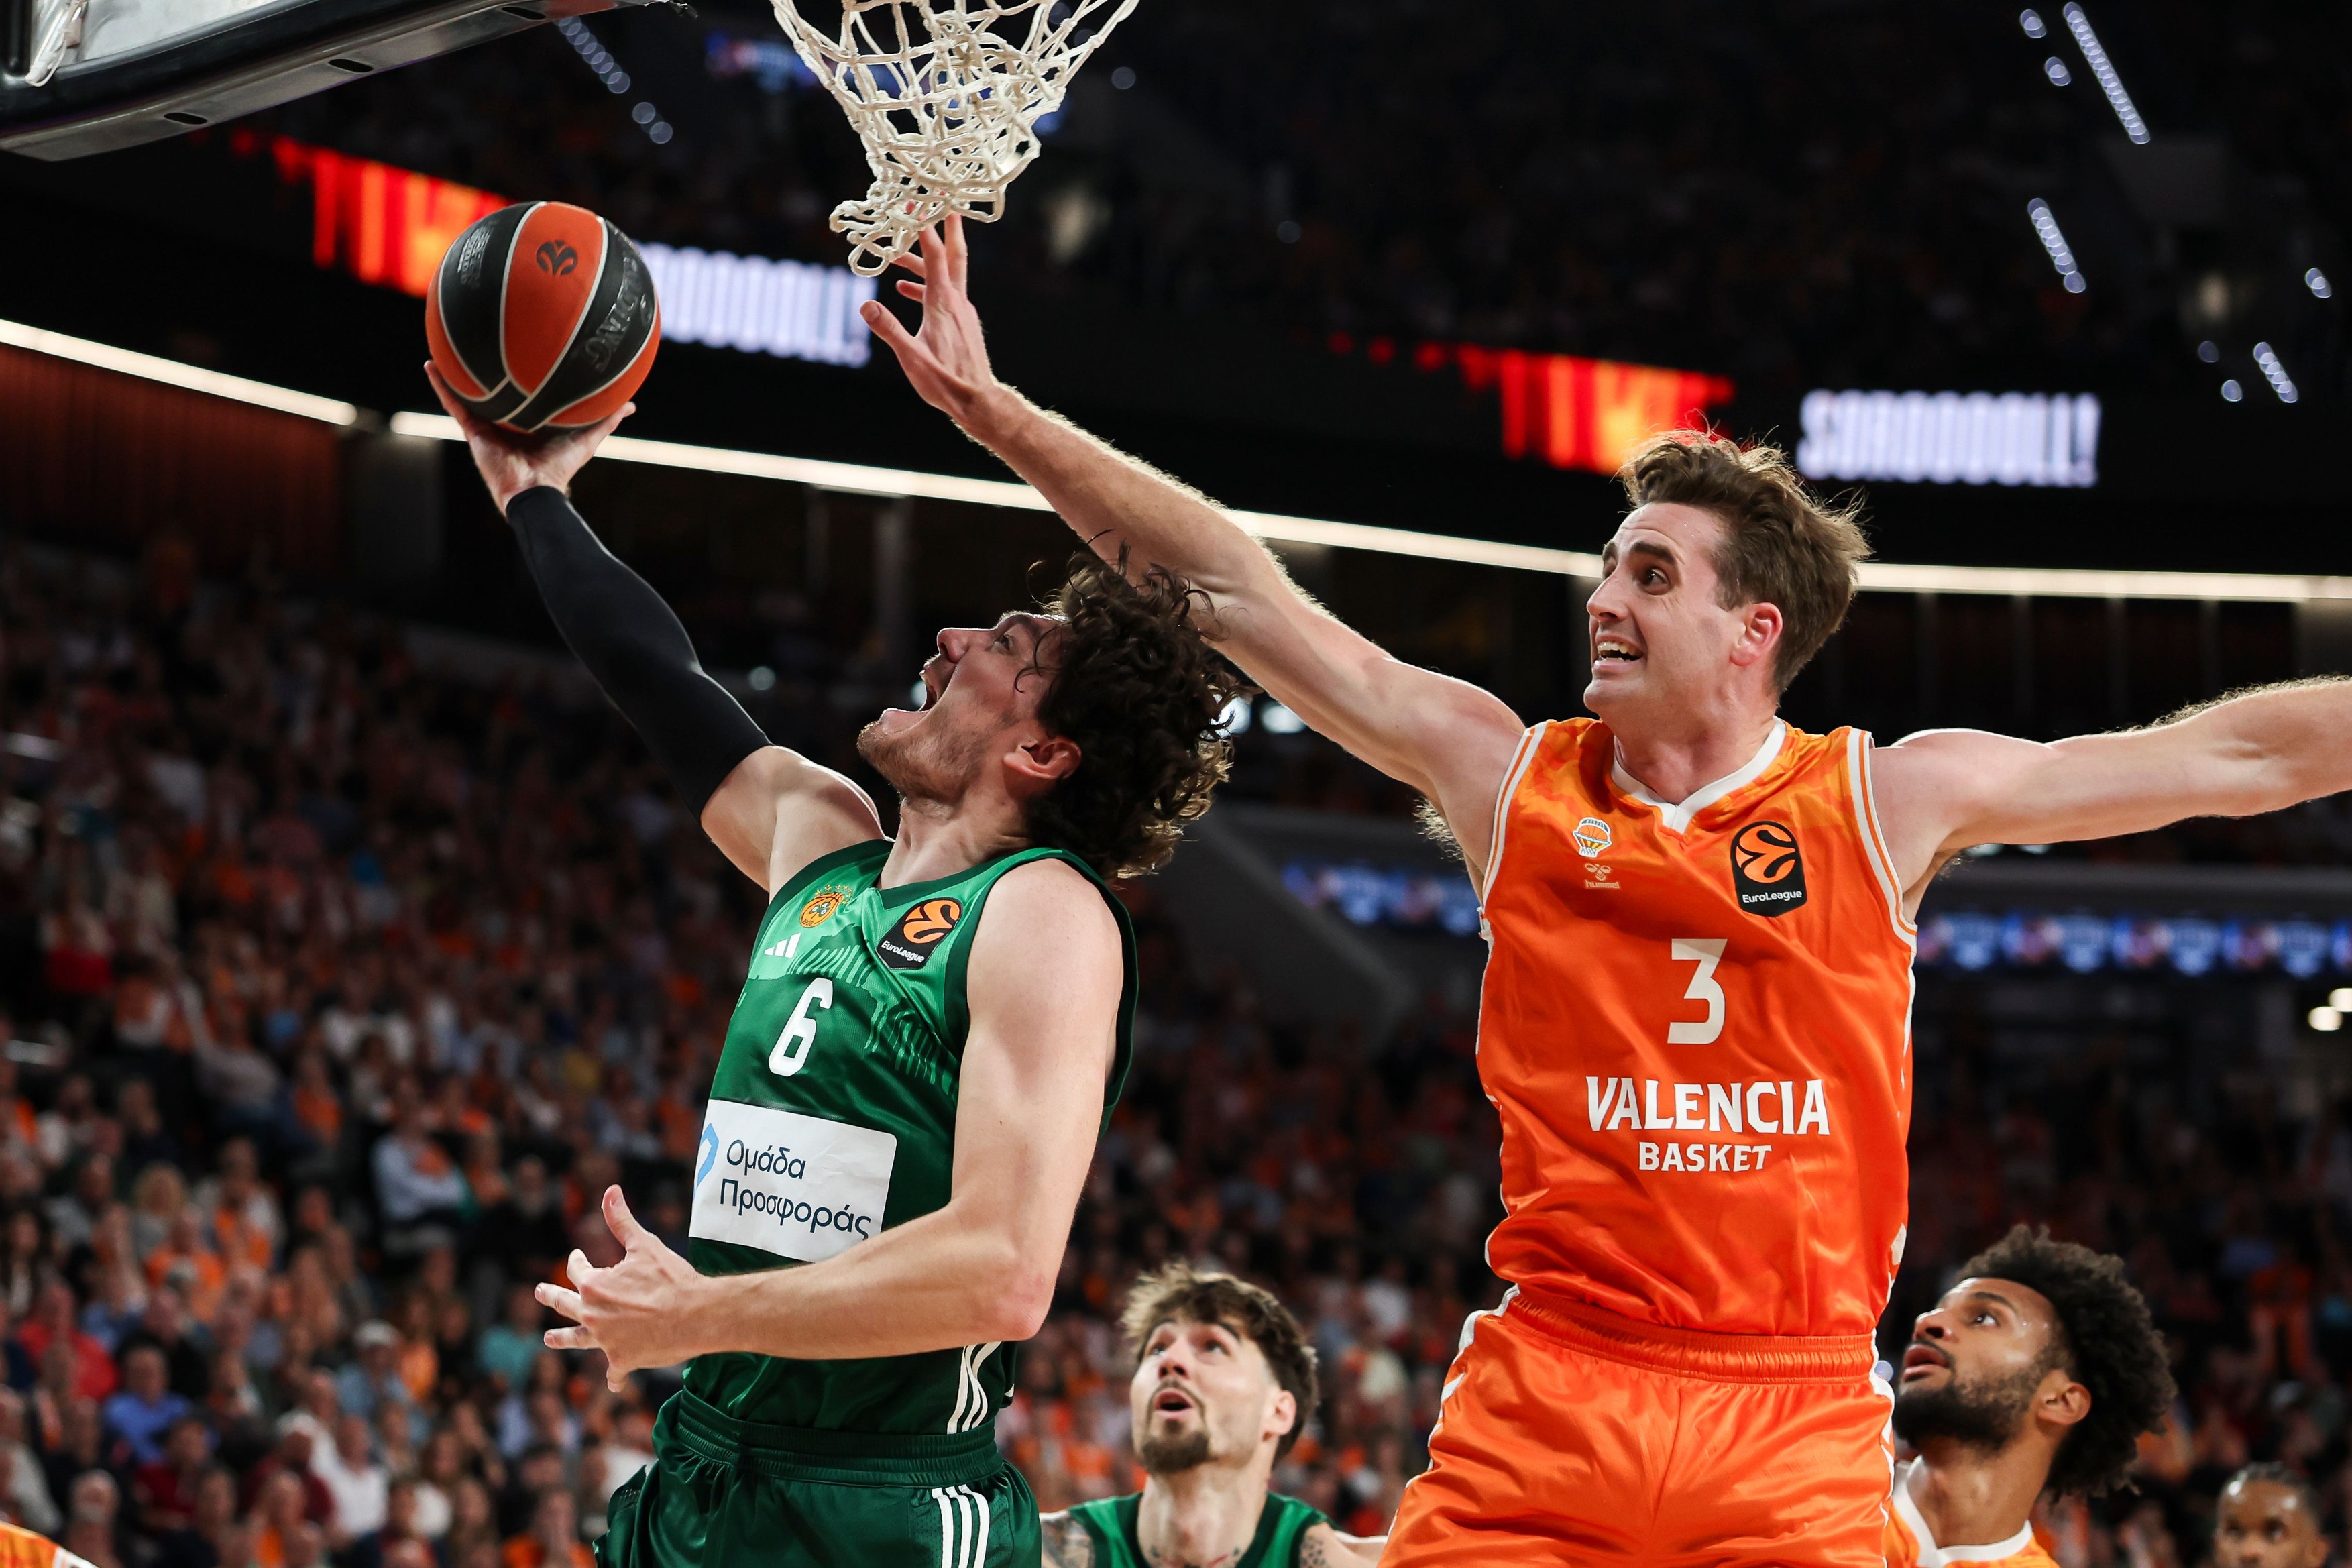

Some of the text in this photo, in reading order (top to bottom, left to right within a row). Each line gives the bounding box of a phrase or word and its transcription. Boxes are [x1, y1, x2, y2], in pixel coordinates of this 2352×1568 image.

[1742, 891, 1802, 903] EuroLeague
[881, 940, 924, 963] EuroLeague
[1667, 938, 1728, 1044] 3
[768, 977, 833, 1076] 6
[1585, 1076, 1830, 1135] VALENCIA
[726, 1139, 805, 1179] Ομάδα
[1638, 1141, 1772, 1172] BASKET
[720, 1178, 871, 1241] Προσφοράς
